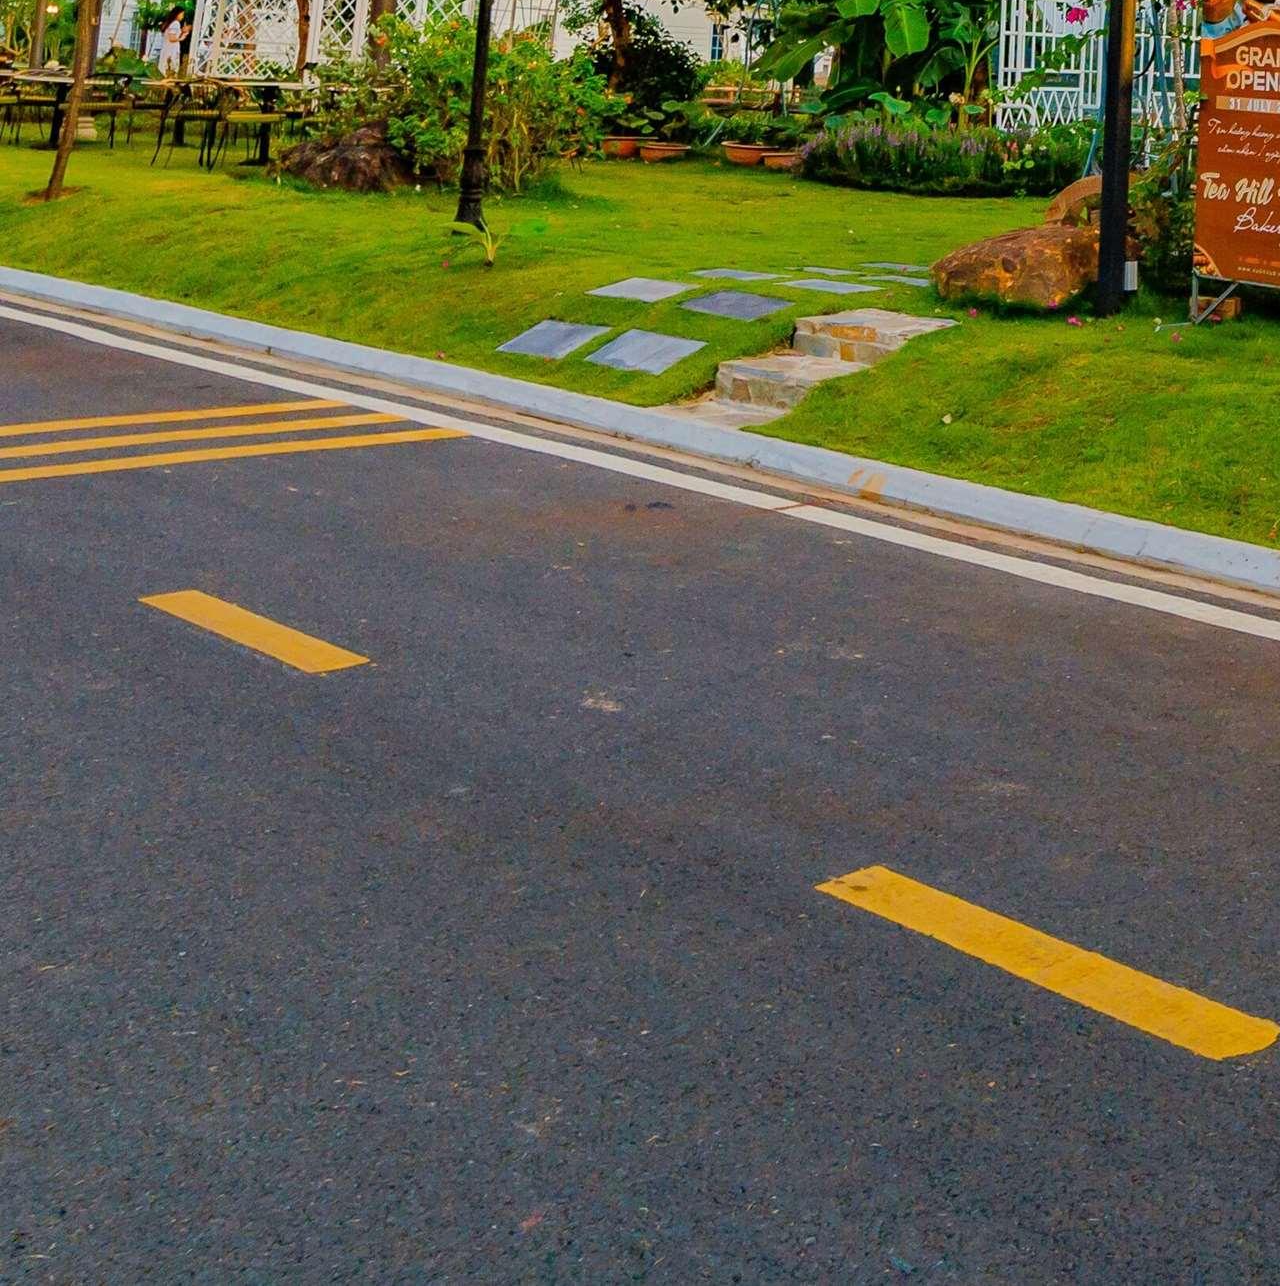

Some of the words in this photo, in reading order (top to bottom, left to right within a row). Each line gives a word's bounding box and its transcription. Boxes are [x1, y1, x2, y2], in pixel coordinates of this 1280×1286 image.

[1229, 97, 1241, 110] 31
[1247, 98, 1271, 112] JULY
[1200, 172, 1231, 201] Tea
[1235, 177, 1275, 205] Hill
